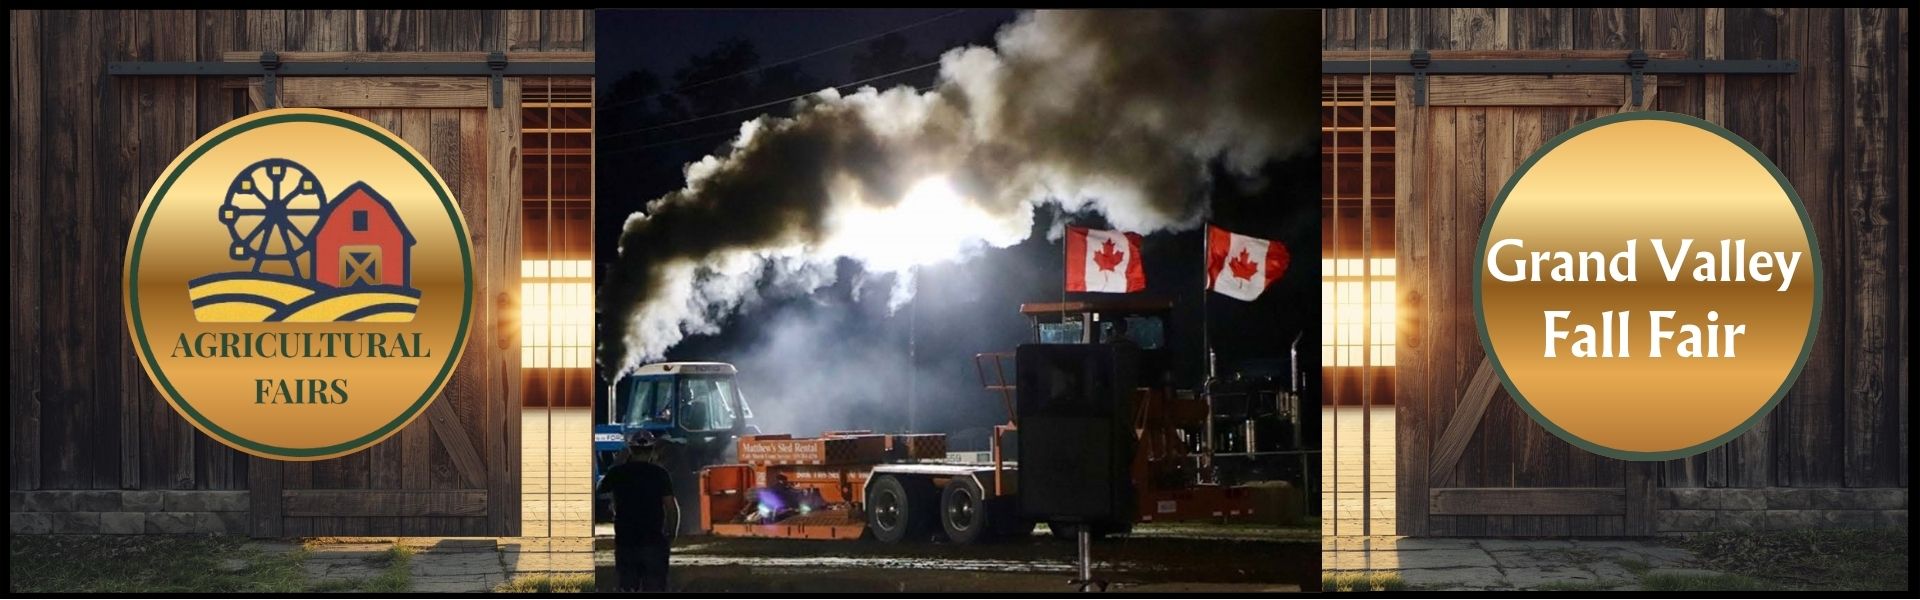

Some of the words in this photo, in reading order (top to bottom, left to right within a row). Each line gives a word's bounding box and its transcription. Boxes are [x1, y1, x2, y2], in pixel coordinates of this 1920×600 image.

[743, 442, 777, 453] Matthew's
[778, 442, 793, 453] Sled
[794, 442, 818, 452] Rental
